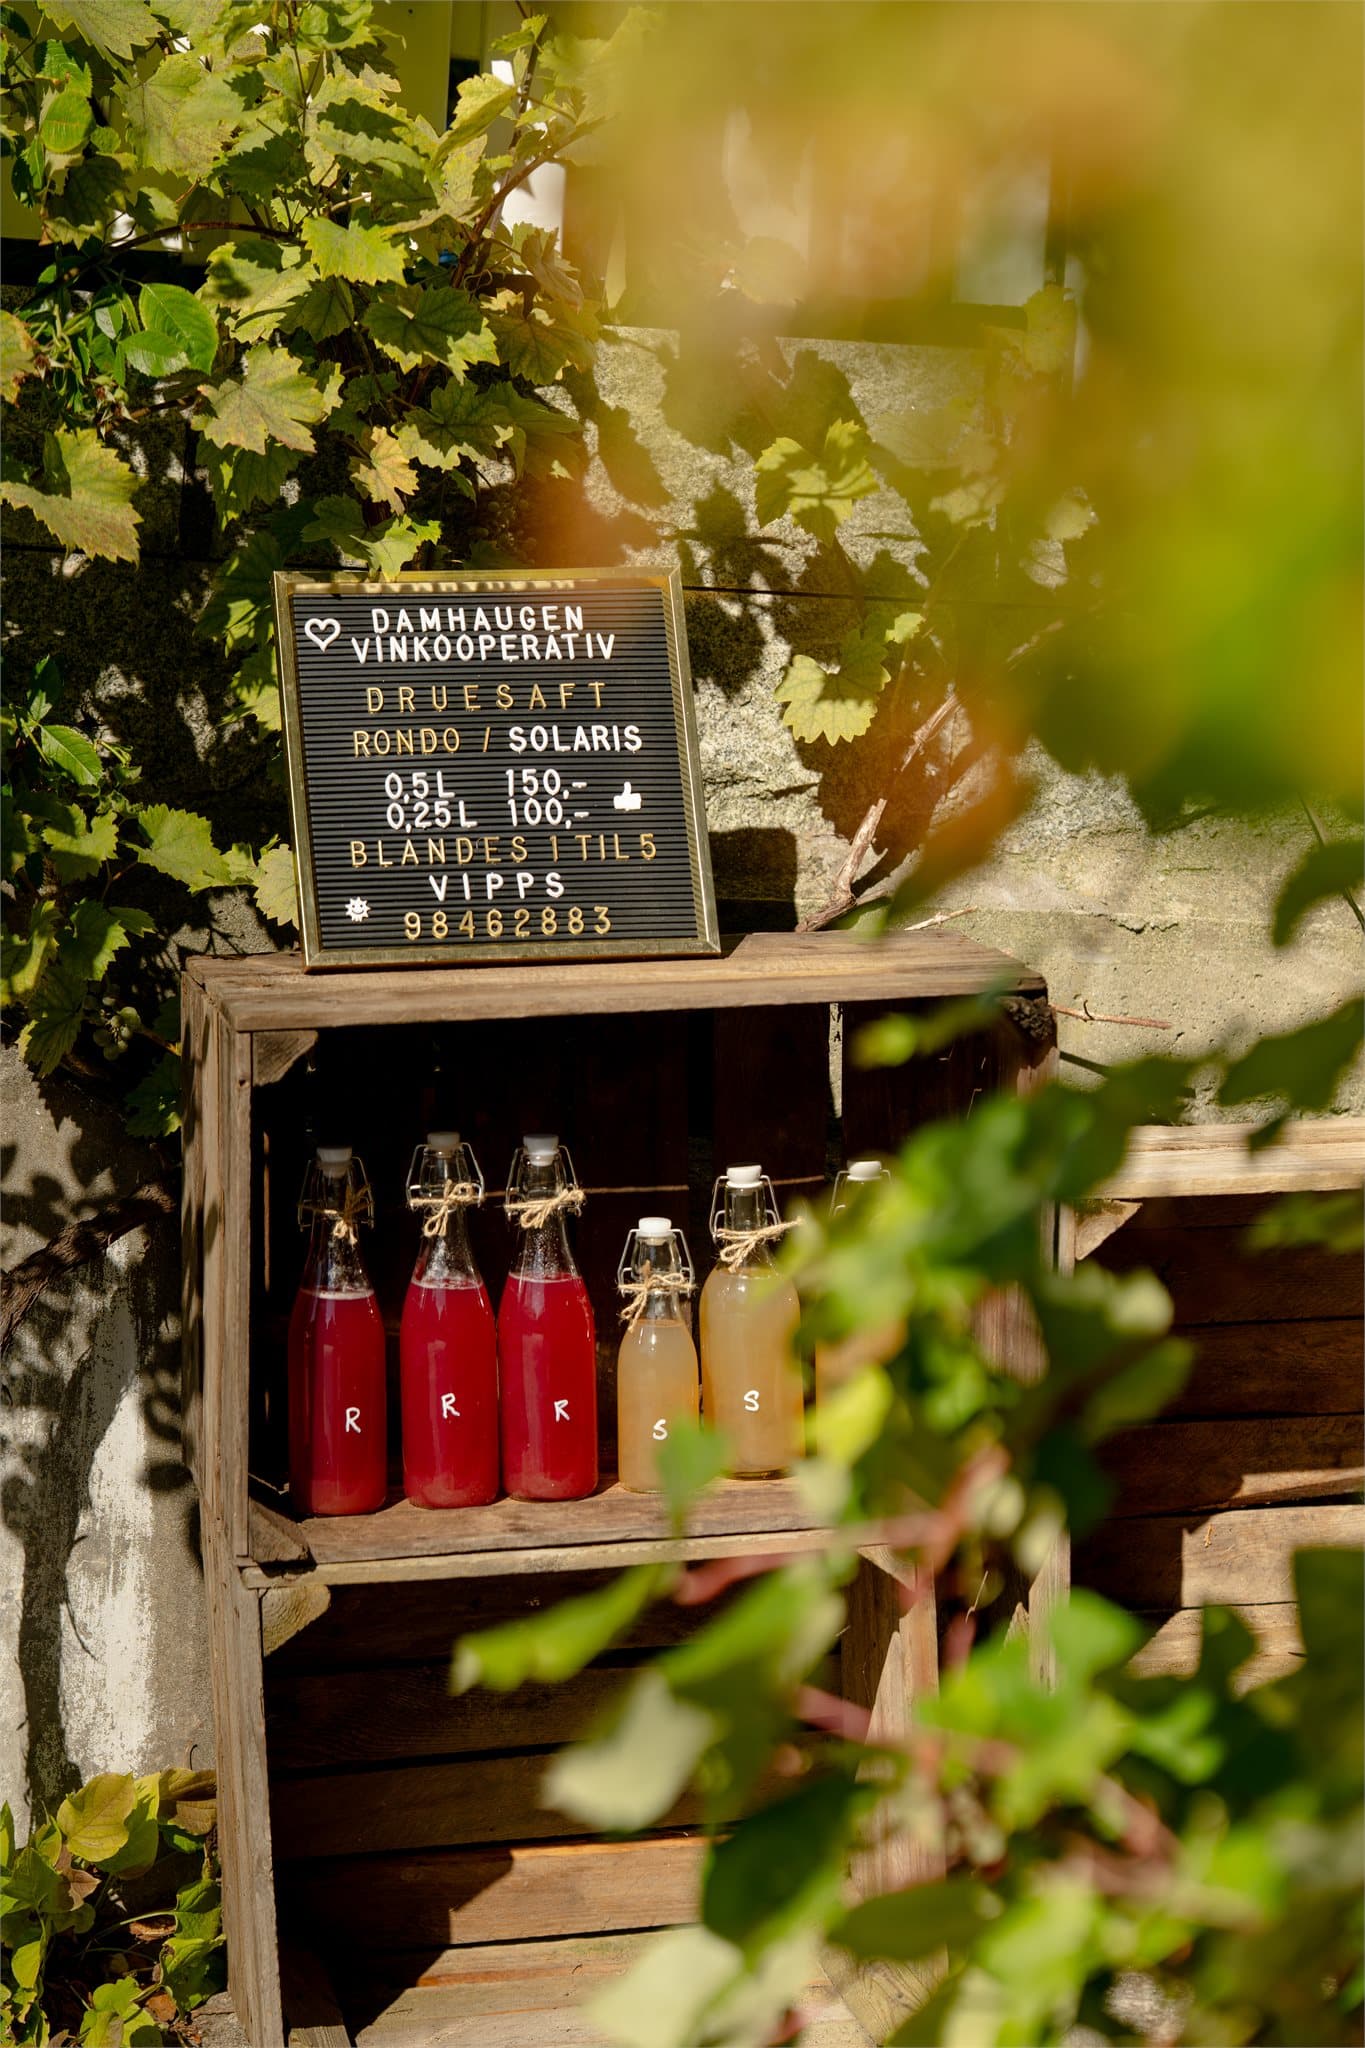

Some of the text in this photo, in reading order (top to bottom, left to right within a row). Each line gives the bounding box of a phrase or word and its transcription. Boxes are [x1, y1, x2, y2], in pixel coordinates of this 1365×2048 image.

[371, 605, 584, 634] DAMHAUGEN
[351, 633, 615, 663] VINKOOPERATIV
[366, 682, 606, 713] DRUESAFT
[352, 724, 643, 757] RONDO / SOLARIS
[384, 770, 455, 802] 0,5L
[386, 800, 478, 833] 0,25L
[350, 836, 528, 867] BLANDES
[429, 872, 564, 901] VIPPS
[404, 906, 612, 940] 98462883
[441, 1392, 460, 1419] R
[553, 1399, 571, 1422] R
[744, 1390, 760, 1412] S
[345, 1407, 361, 1433] R
[652, 1419, 668, 1441] S
